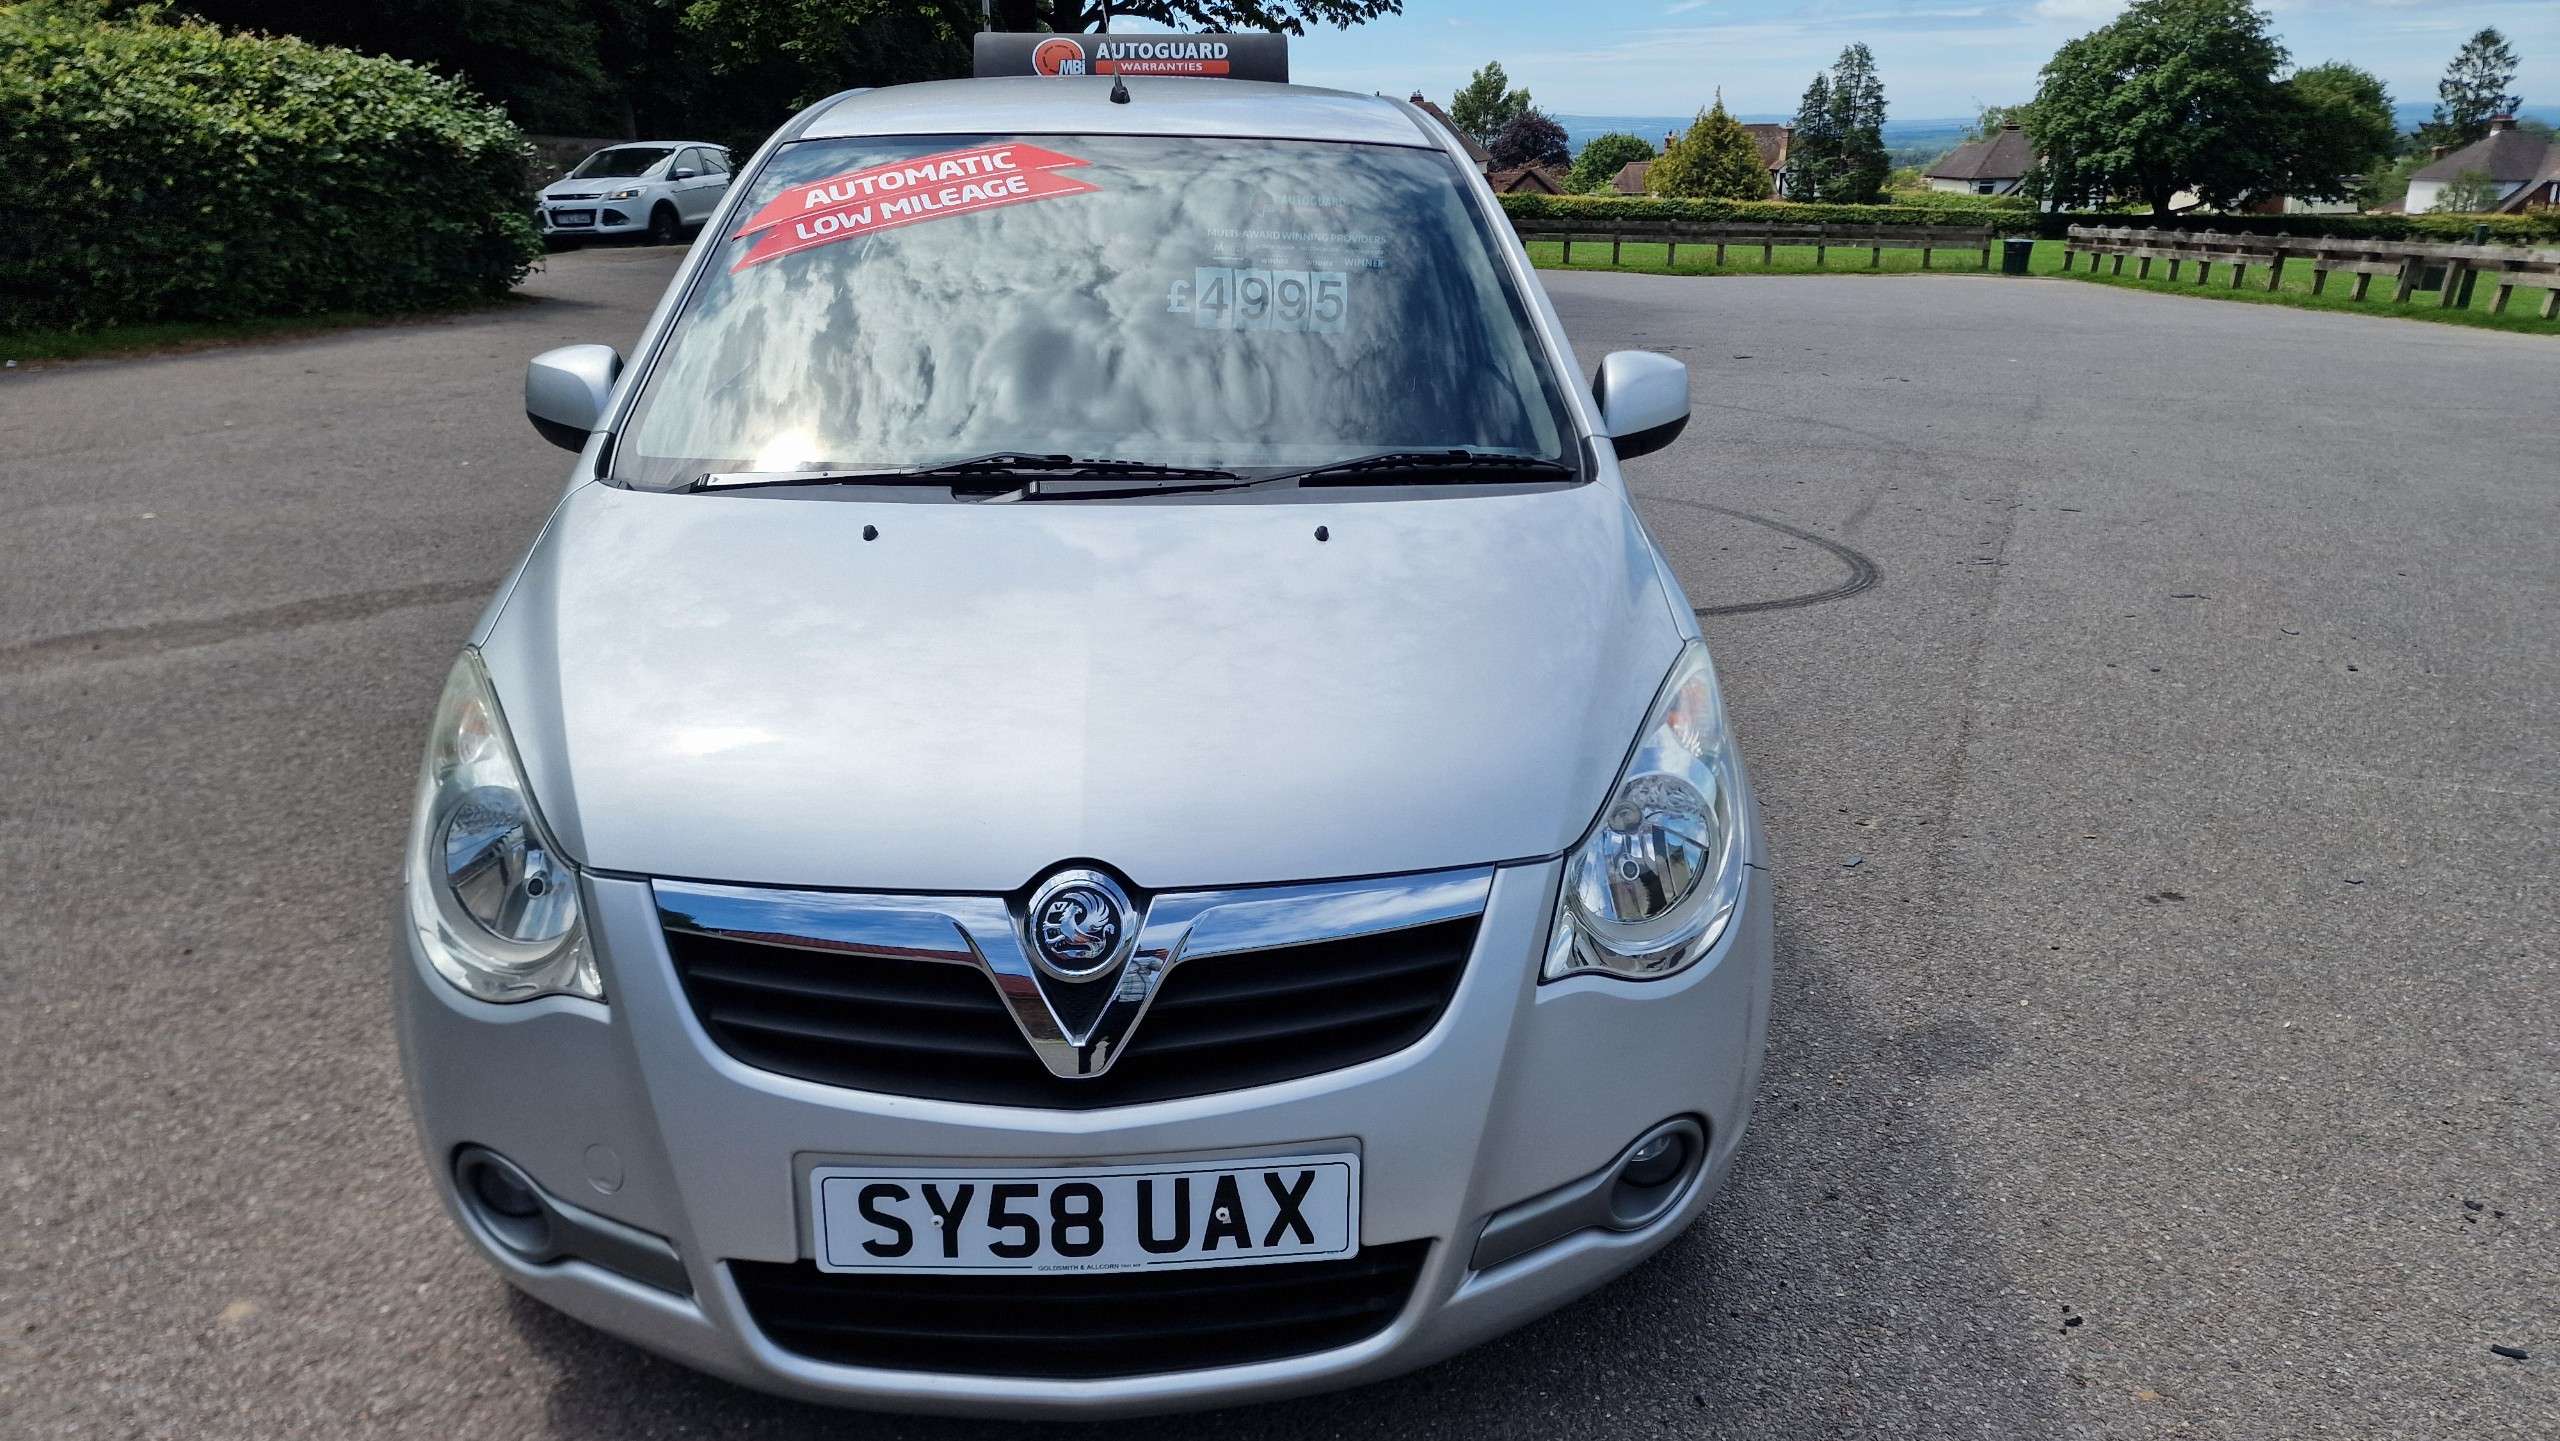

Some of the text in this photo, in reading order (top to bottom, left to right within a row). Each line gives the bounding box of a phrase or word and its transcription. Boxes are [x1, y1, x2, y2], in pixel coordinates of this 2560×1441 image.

[1096, 42, 1228, 59] AUTOGUARD
[1121, 61, 1203, 72] WARRANTIES
[795, 175, 1030, 240] LOW MILEAGE
[804, 151, 1017, 209] AUTOMATIC
[858, 1170, 1317, 1259] SY58 UAX
